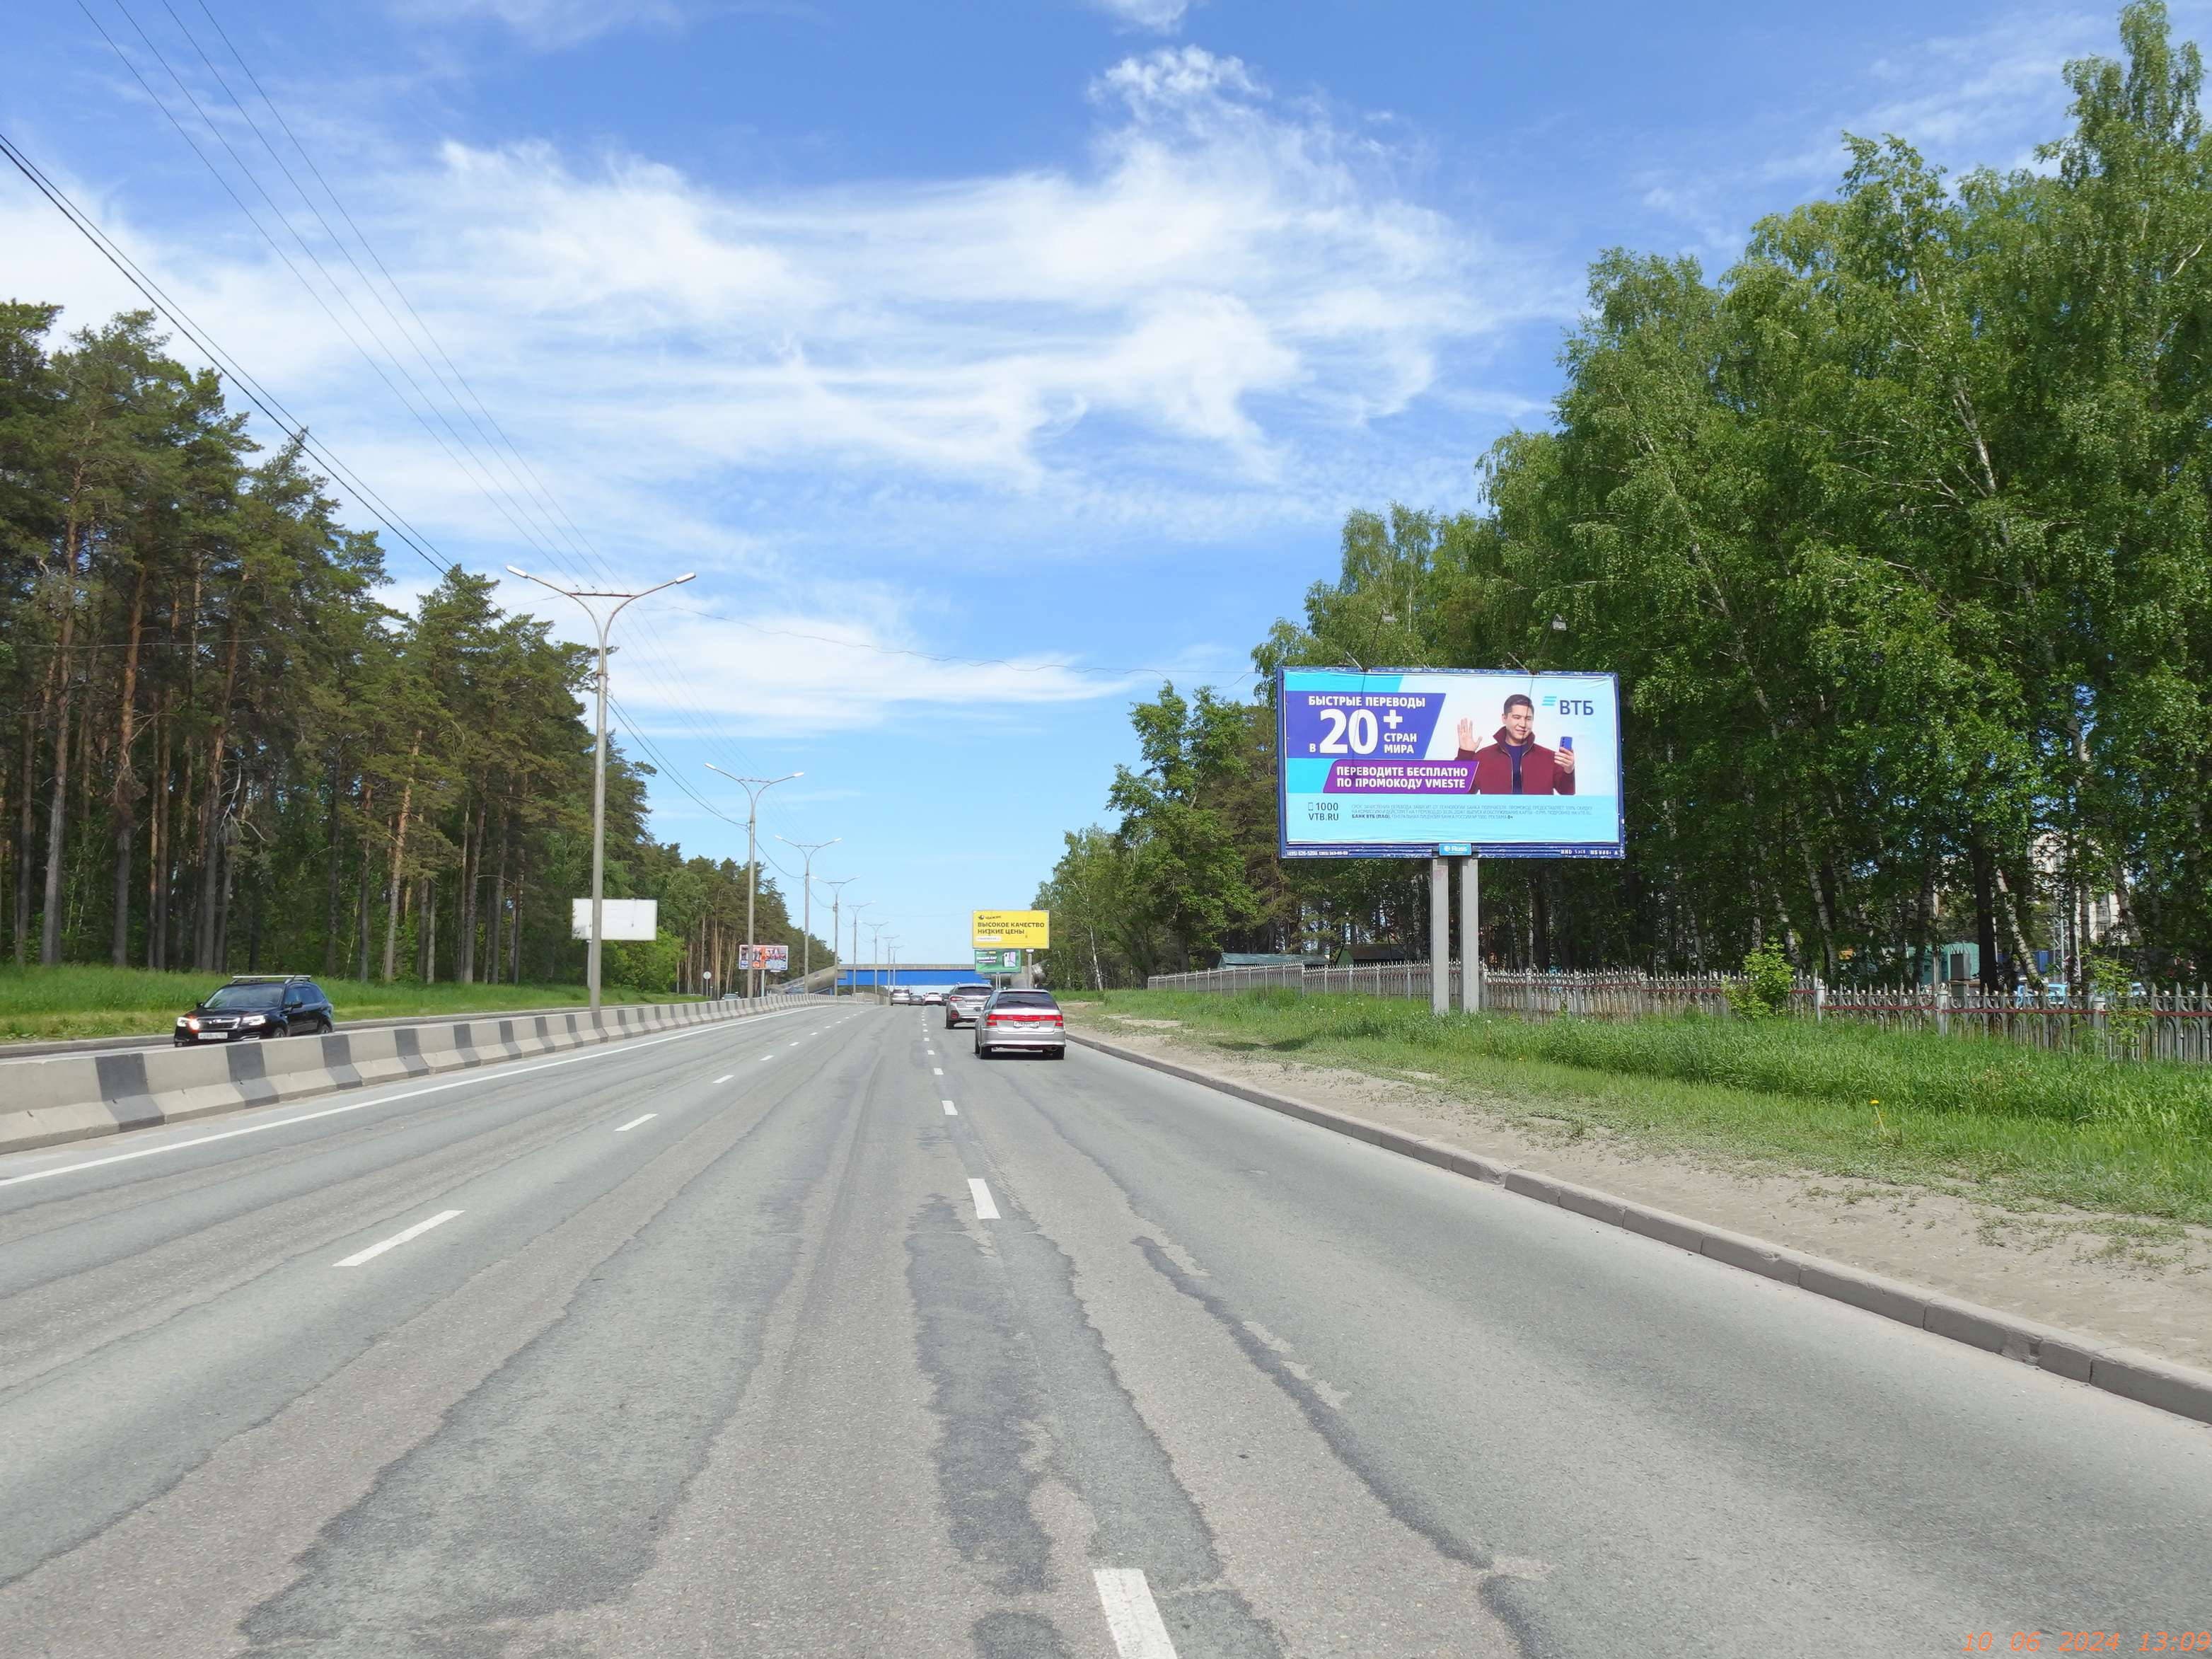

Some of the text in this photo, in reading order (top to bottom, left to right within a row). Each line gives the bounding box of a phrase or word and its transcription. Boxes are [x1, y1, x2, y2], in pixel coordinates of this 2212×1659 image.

[1309, 696, 1425, 709] БЫСТРЫЕ ПЕРЕВОДЫ
[1560, 700, 1594, 715] ВТБ
[1384, 733, 1417, 742] СТРАН
[1384, 744, 1414, 753] МИРА
[1337, 766, 1468, 778] ПЕРЕВОДИТЕ БЕСПЛАТНО
[1337, 778, 1466, 790] ПО ПРОМОКОДУ VMESTE
[1316, 802, 1338, 811] 1000
[1309, 813, 1339, 821] VTB.RU
